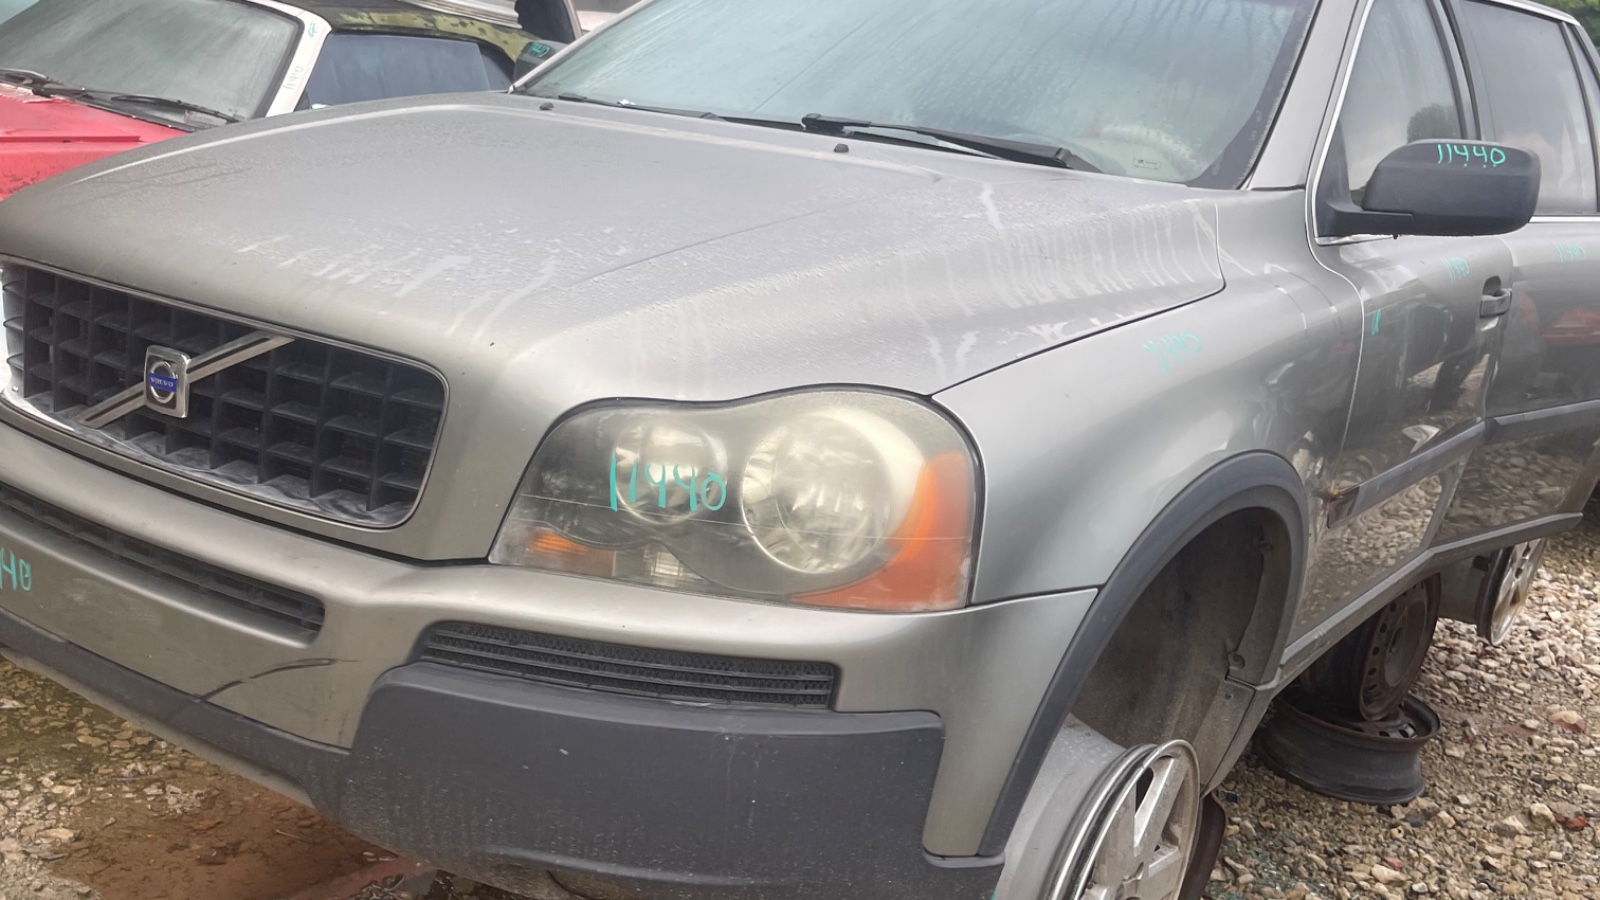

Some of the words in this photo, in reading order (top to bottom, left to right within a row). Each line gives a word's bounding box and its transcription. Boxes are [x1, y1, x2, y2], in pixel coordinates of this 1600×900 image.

[1437, 143, 1506, 166] 11440
[150, 376, 174, 388] VOLVO
[609, 451, 727, 512] 11440
